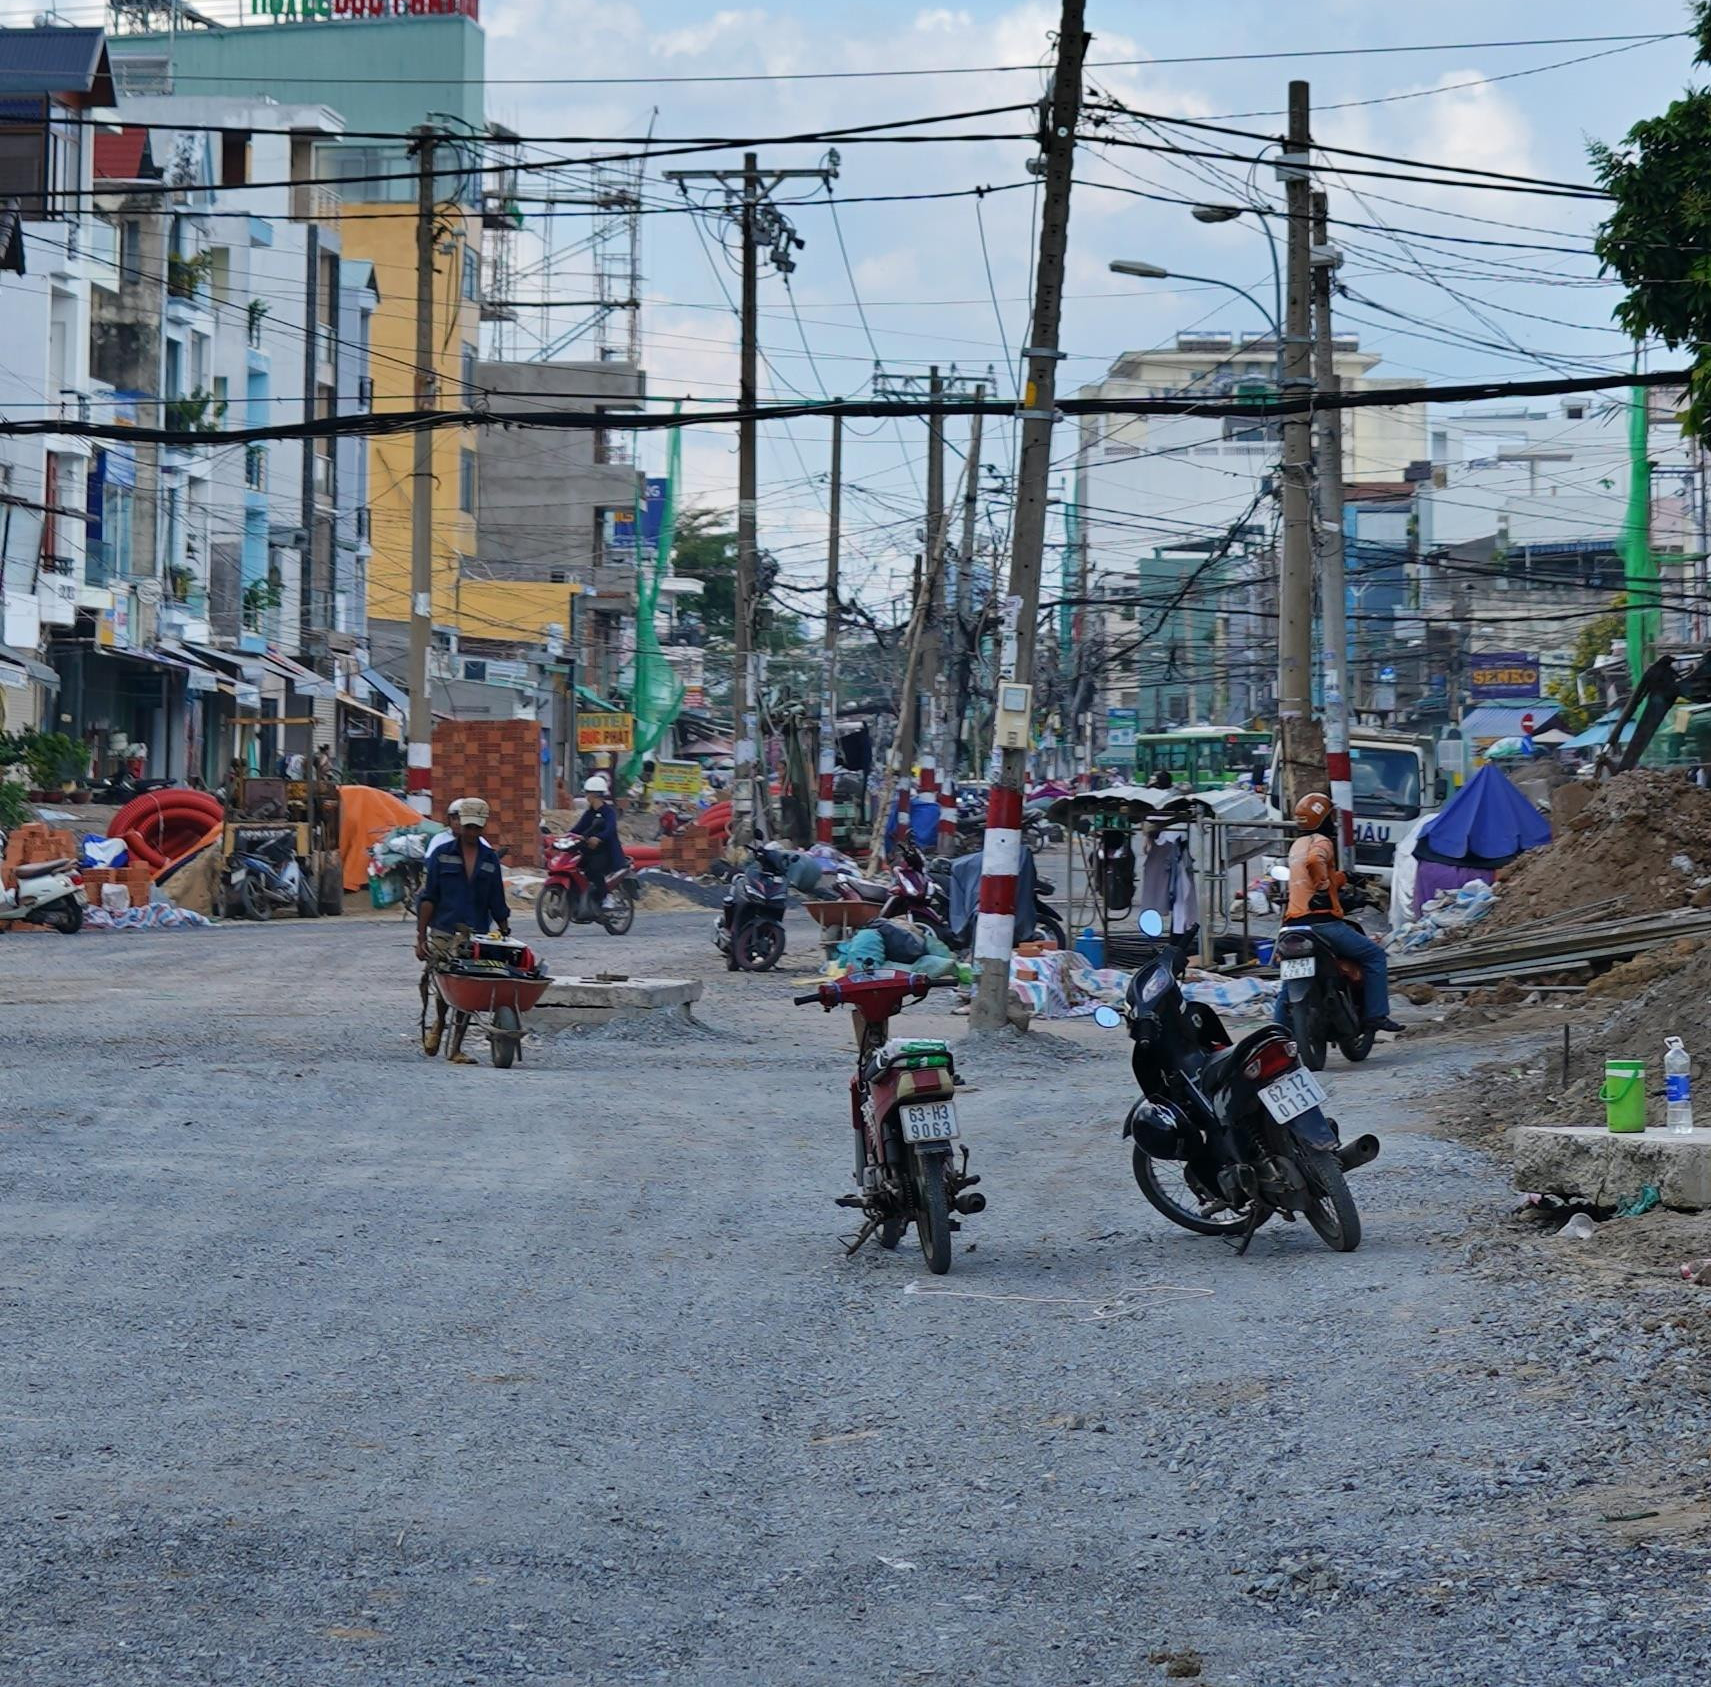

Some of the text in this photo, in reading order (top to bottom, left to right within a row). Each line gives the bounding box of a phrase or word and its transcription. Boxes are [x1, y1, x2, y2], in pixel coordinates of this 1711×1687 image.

[580, 715, 629, 728] HOTEL
[1278, 1087, 1319, 1118] 0131
[908, 1104, 949, 1123] 63-H3
[911, 1121, 952, 1139] 9063
